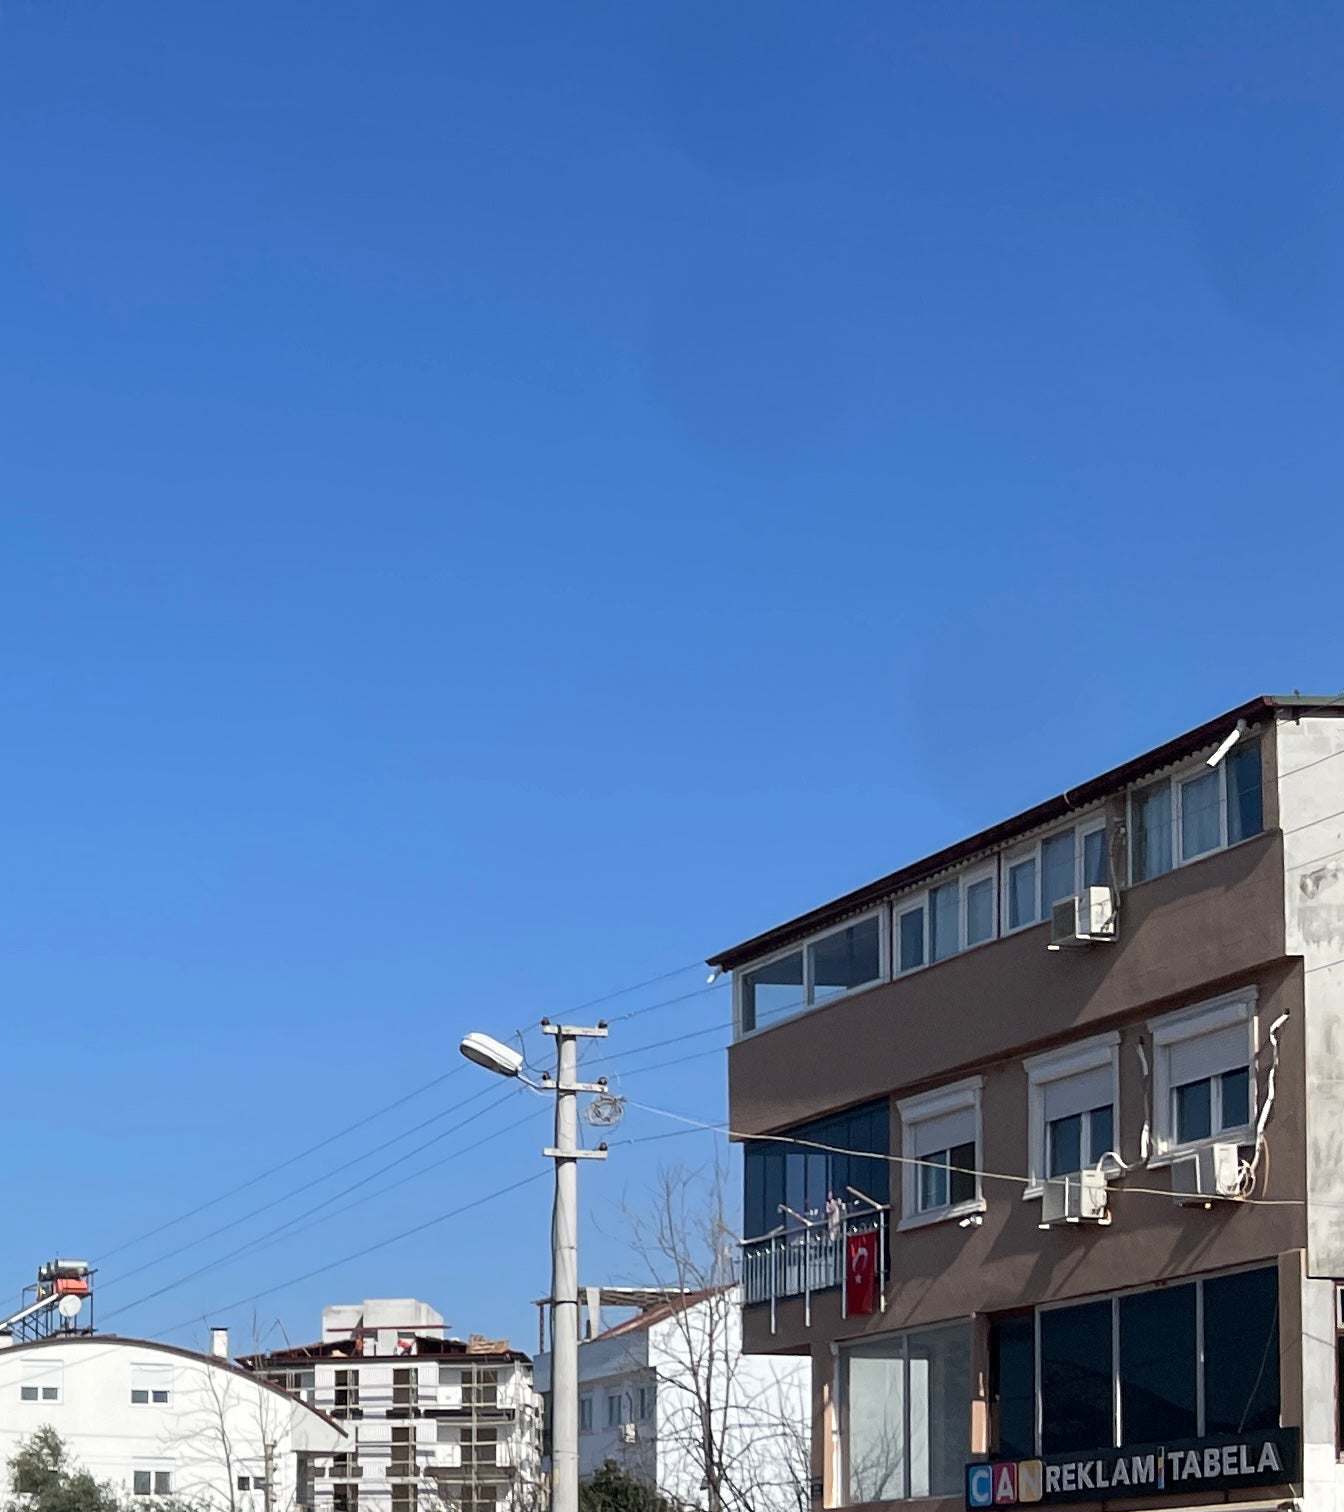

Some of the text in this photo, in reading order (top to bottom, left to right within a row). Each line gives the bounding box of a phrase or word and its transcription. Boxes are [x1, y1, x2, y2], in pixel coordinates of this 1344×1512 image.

[970, 1441, 1284, 1504] CAN REKLAM TABELA
